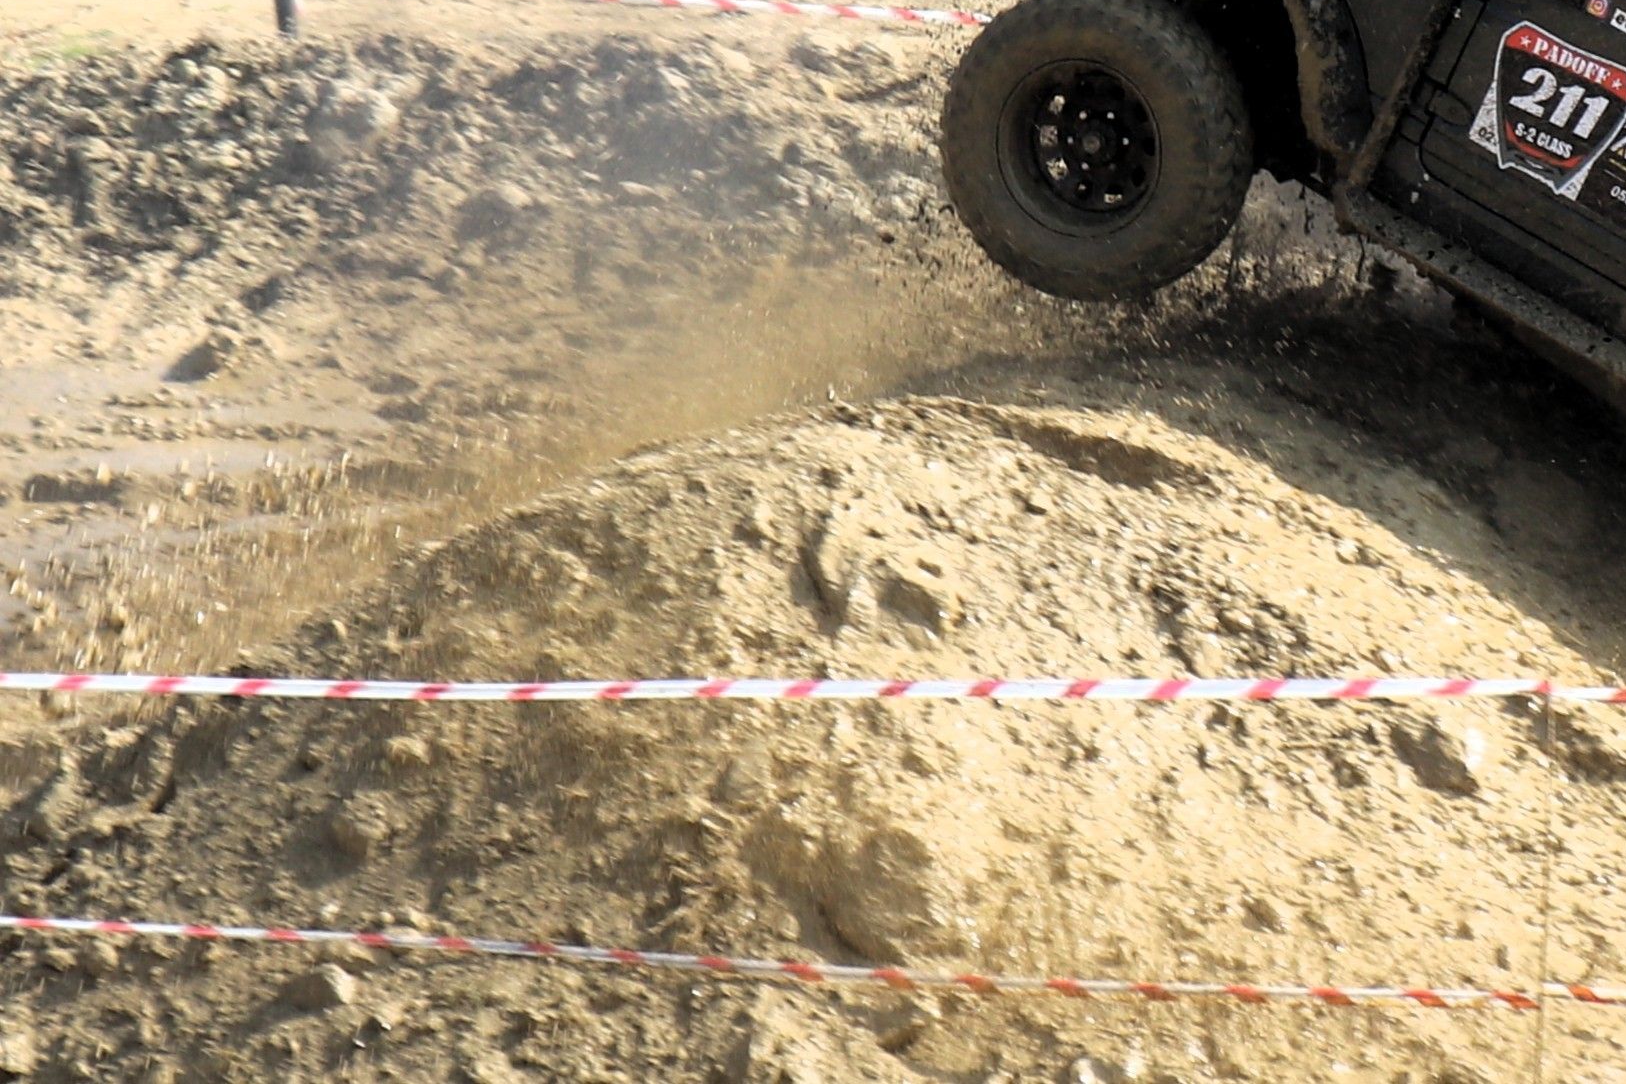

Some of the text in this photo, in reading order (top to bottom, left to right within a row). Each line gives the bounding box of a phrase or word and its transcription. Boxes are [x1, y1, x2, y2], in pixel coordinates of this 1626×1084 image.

[1533, 37, 1612, 85] PADOFF
[1509, 67, 1610, 140] 211
[1515, 122, 1573, 158] S-2 CLASS
